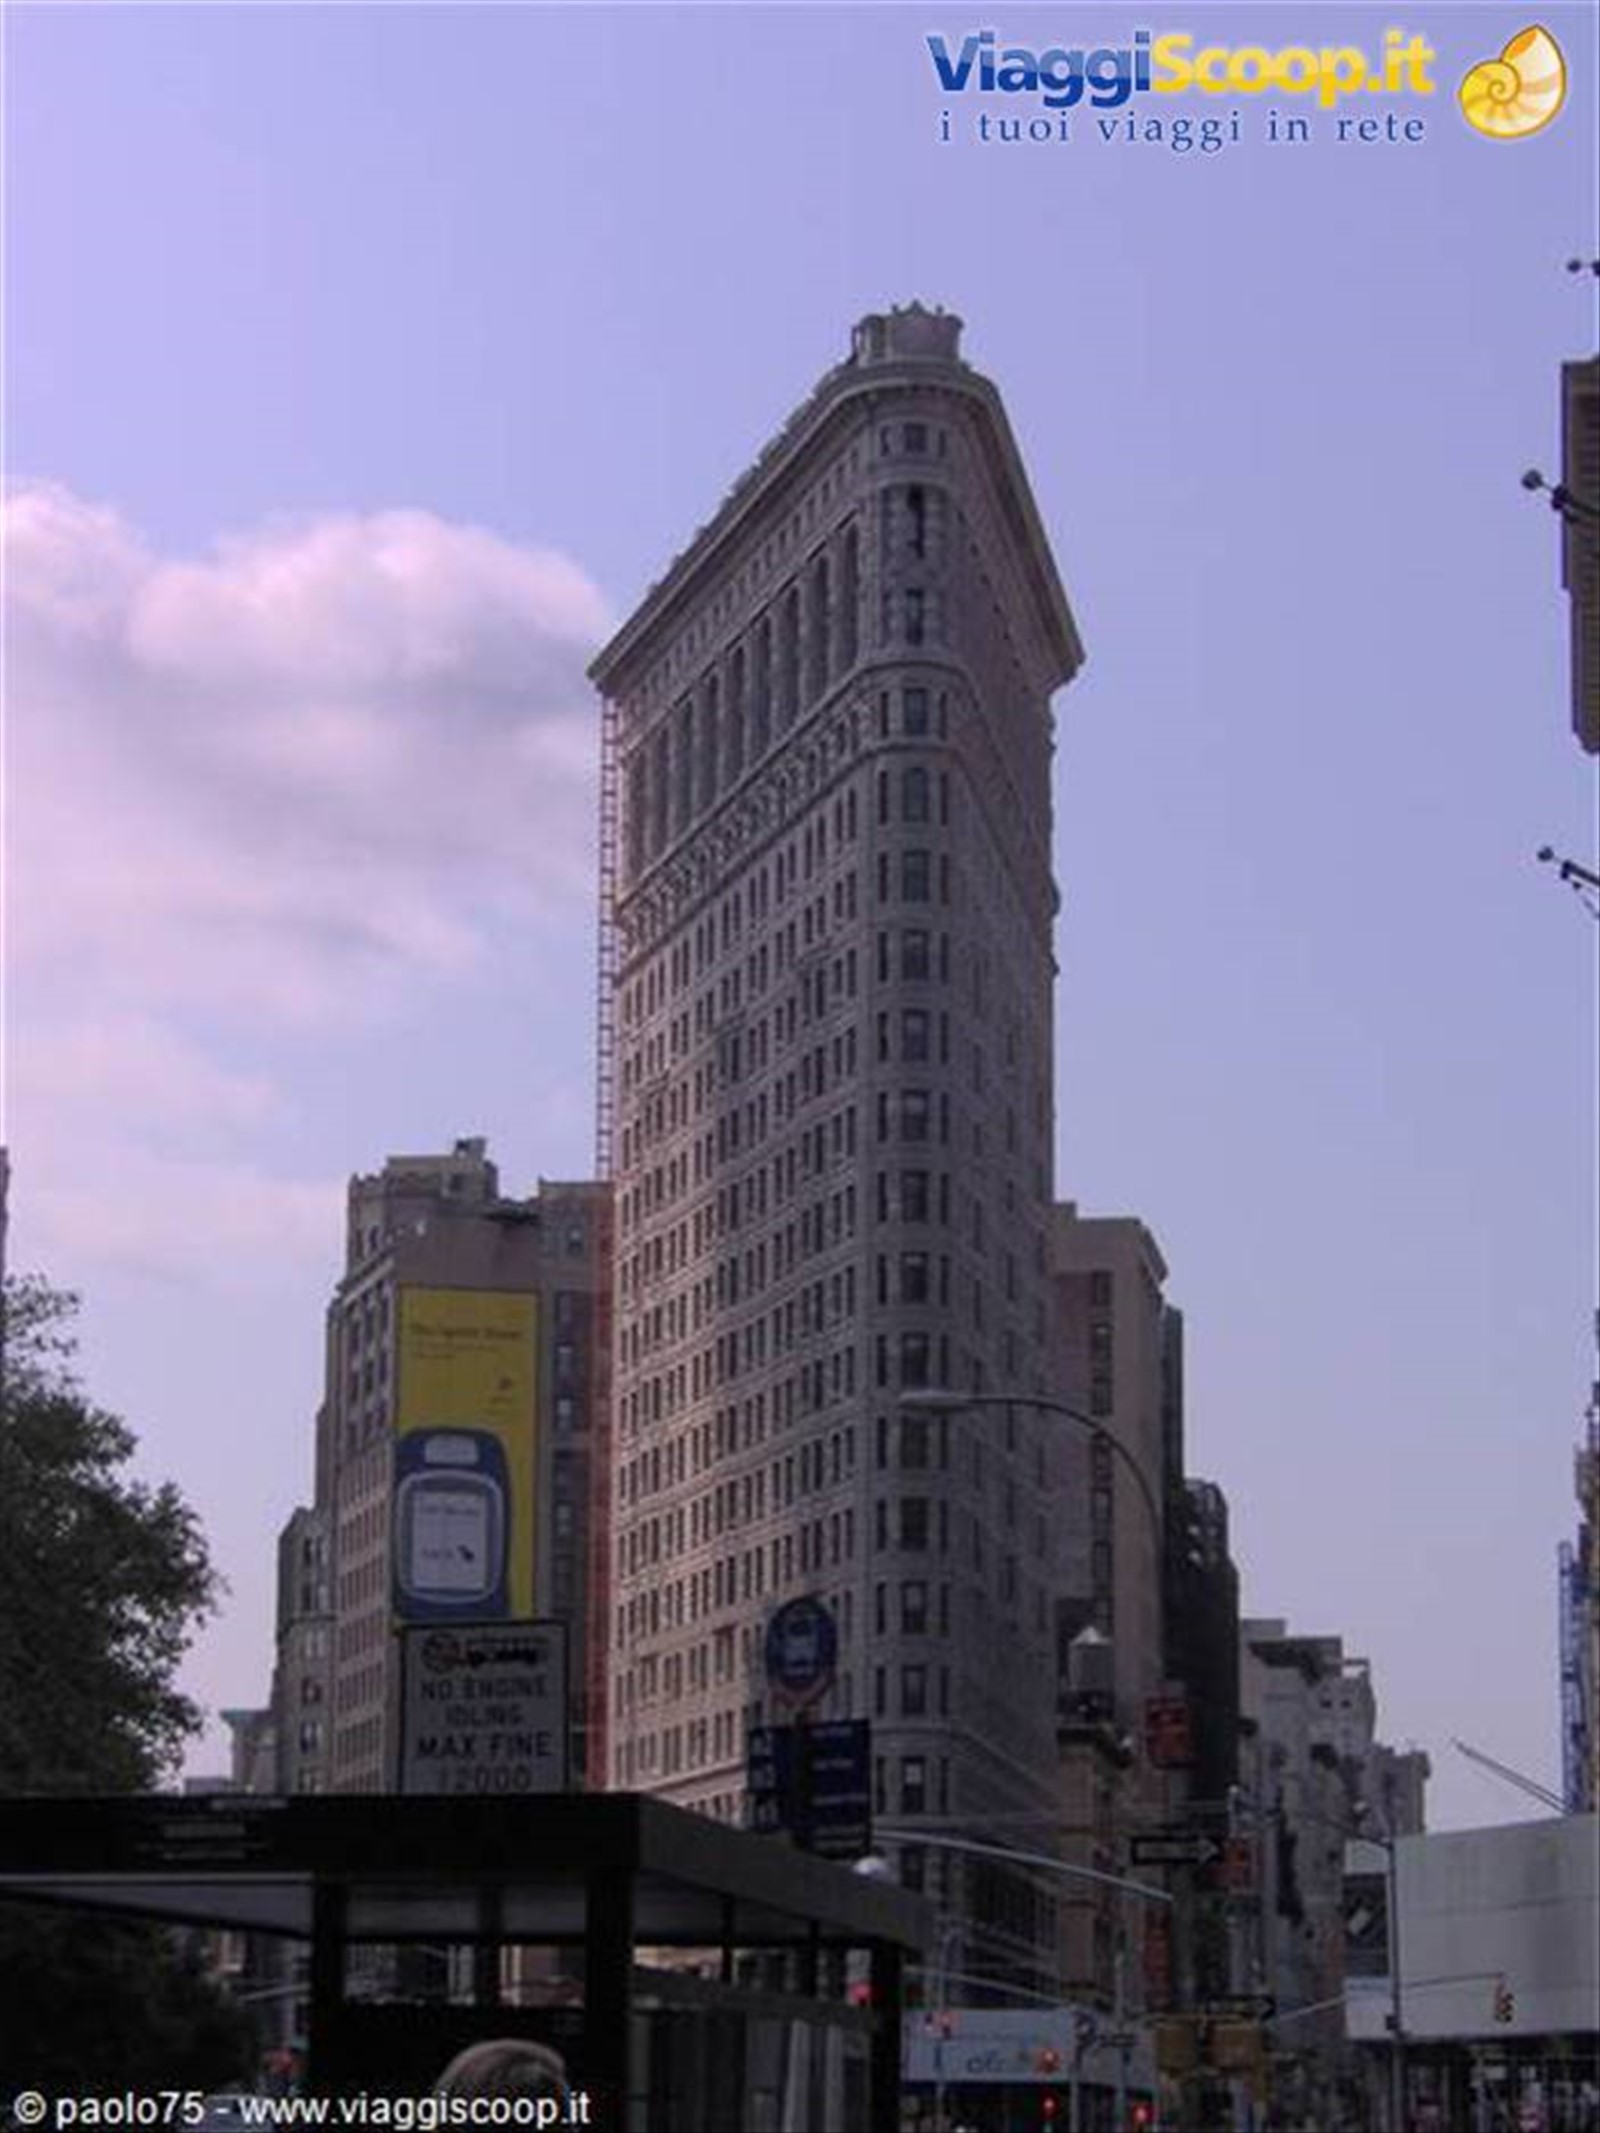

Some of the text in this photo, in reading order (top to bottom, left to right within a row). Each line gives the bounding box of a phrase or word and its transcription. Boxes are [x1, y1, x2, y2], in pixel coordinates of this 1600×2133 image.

[420, 1675, 547, 1701] NO ENGINE
[444, 1703, 524, 1727] IDLING
[417, 1731, 553, 1759] MAX FINE
